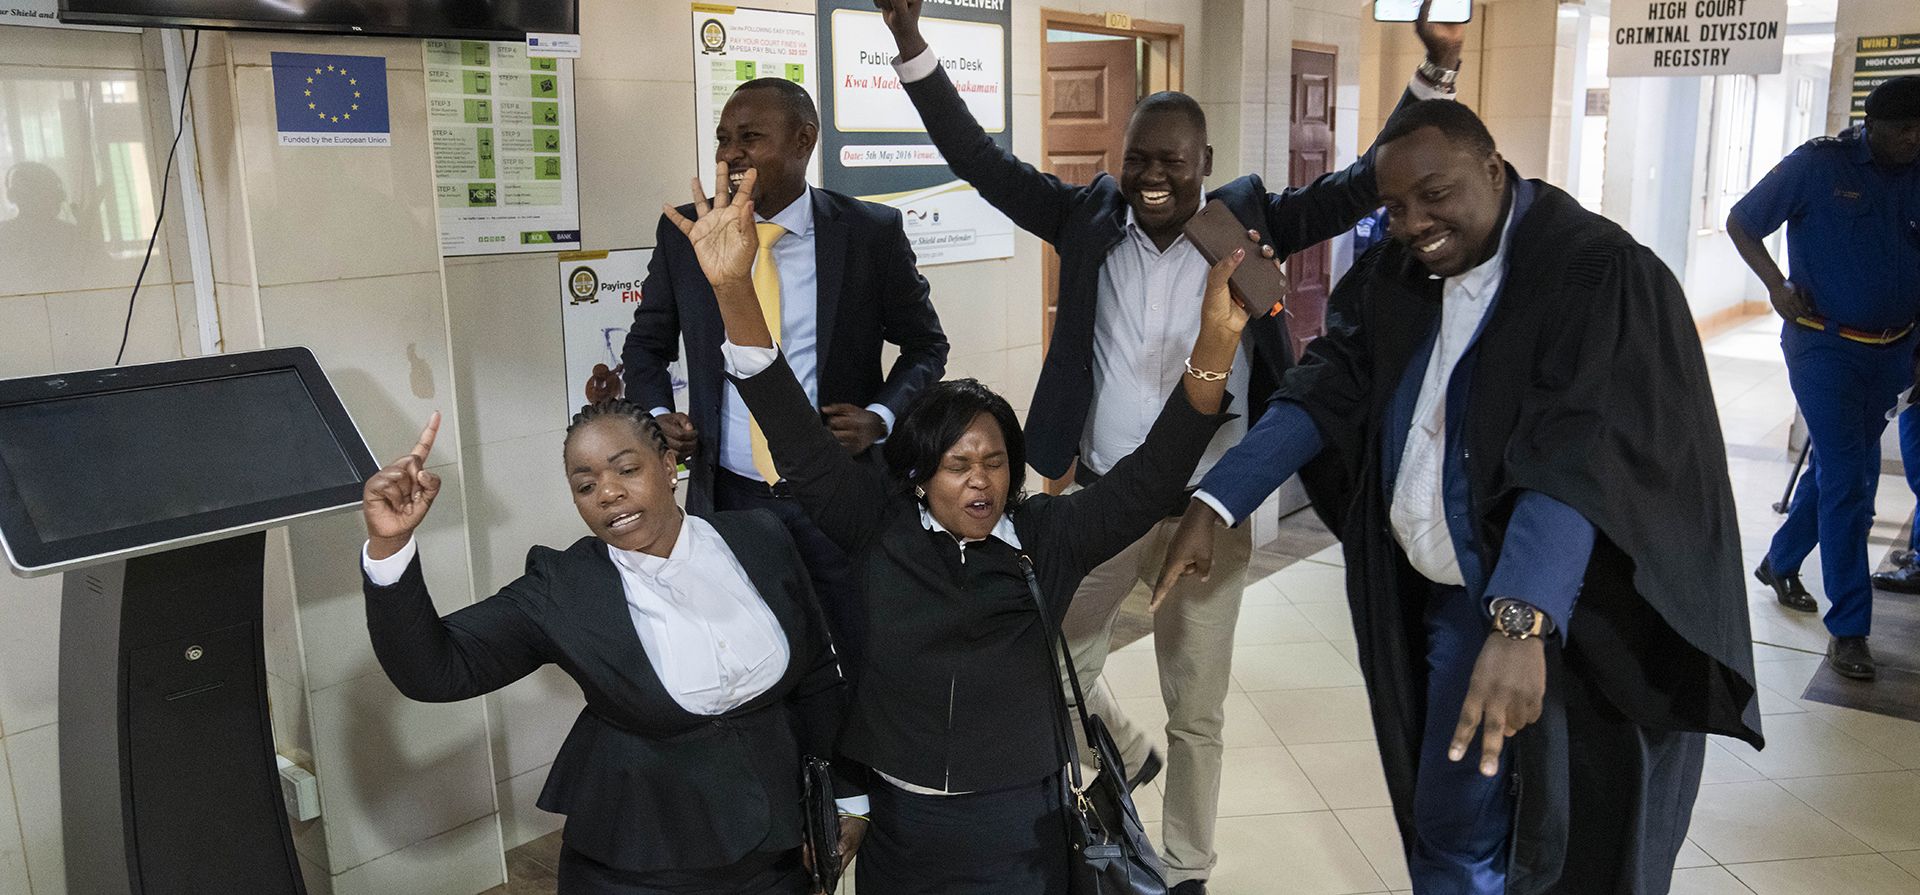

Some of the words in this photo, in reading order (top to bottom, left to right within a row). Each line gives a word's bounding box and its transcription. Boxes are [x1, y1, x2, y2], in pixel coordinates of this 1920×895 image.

[10, 9, 37, 17] Shield
[1648, 1, 1687, 20] HIGH
[1695, 0, 1746, 18] COURT
[1110, 14, 1127, 28] 070
[1616, 24, 1691, 45] CRIMINAL
[1700, 21, 1778, 42] DIVISION
[1862, 37, 1889, 49] WING
[859, 51, 894, 66] Public
[938, 57, 957, 70] tion
[960, 57, 983, 71] Desk
[1653, 48, 1730, 67] REGISTRY
[1865, 57, 1887, 67] HIGH
[1887, 56, 1917, 66] COURT
[844, 74, 868, 88] Kwa
[871, 75, 901, 90] Maele
[955, 80, 998, 94] hakamani
[283, 135, 310, 144] Funded
[311, 136, 320, 145] by
[321, 136, 332, 144] the
[334, 136, 367, 145] European
[367, 136, 387, 144] Union
[843, 150, 863, 162] Date:
[865, 151, 877, 161] 5th
[879, 151, 895, 163] May
[895, 150, 912, 160] 2016
[918, 235, 937, 245] Shield
[936, 235, 948, 244] and
[948, 234, 972, 244] Defender
[601, 281, 632, 292] Paying
[622, 290, 644, 303] FIN
